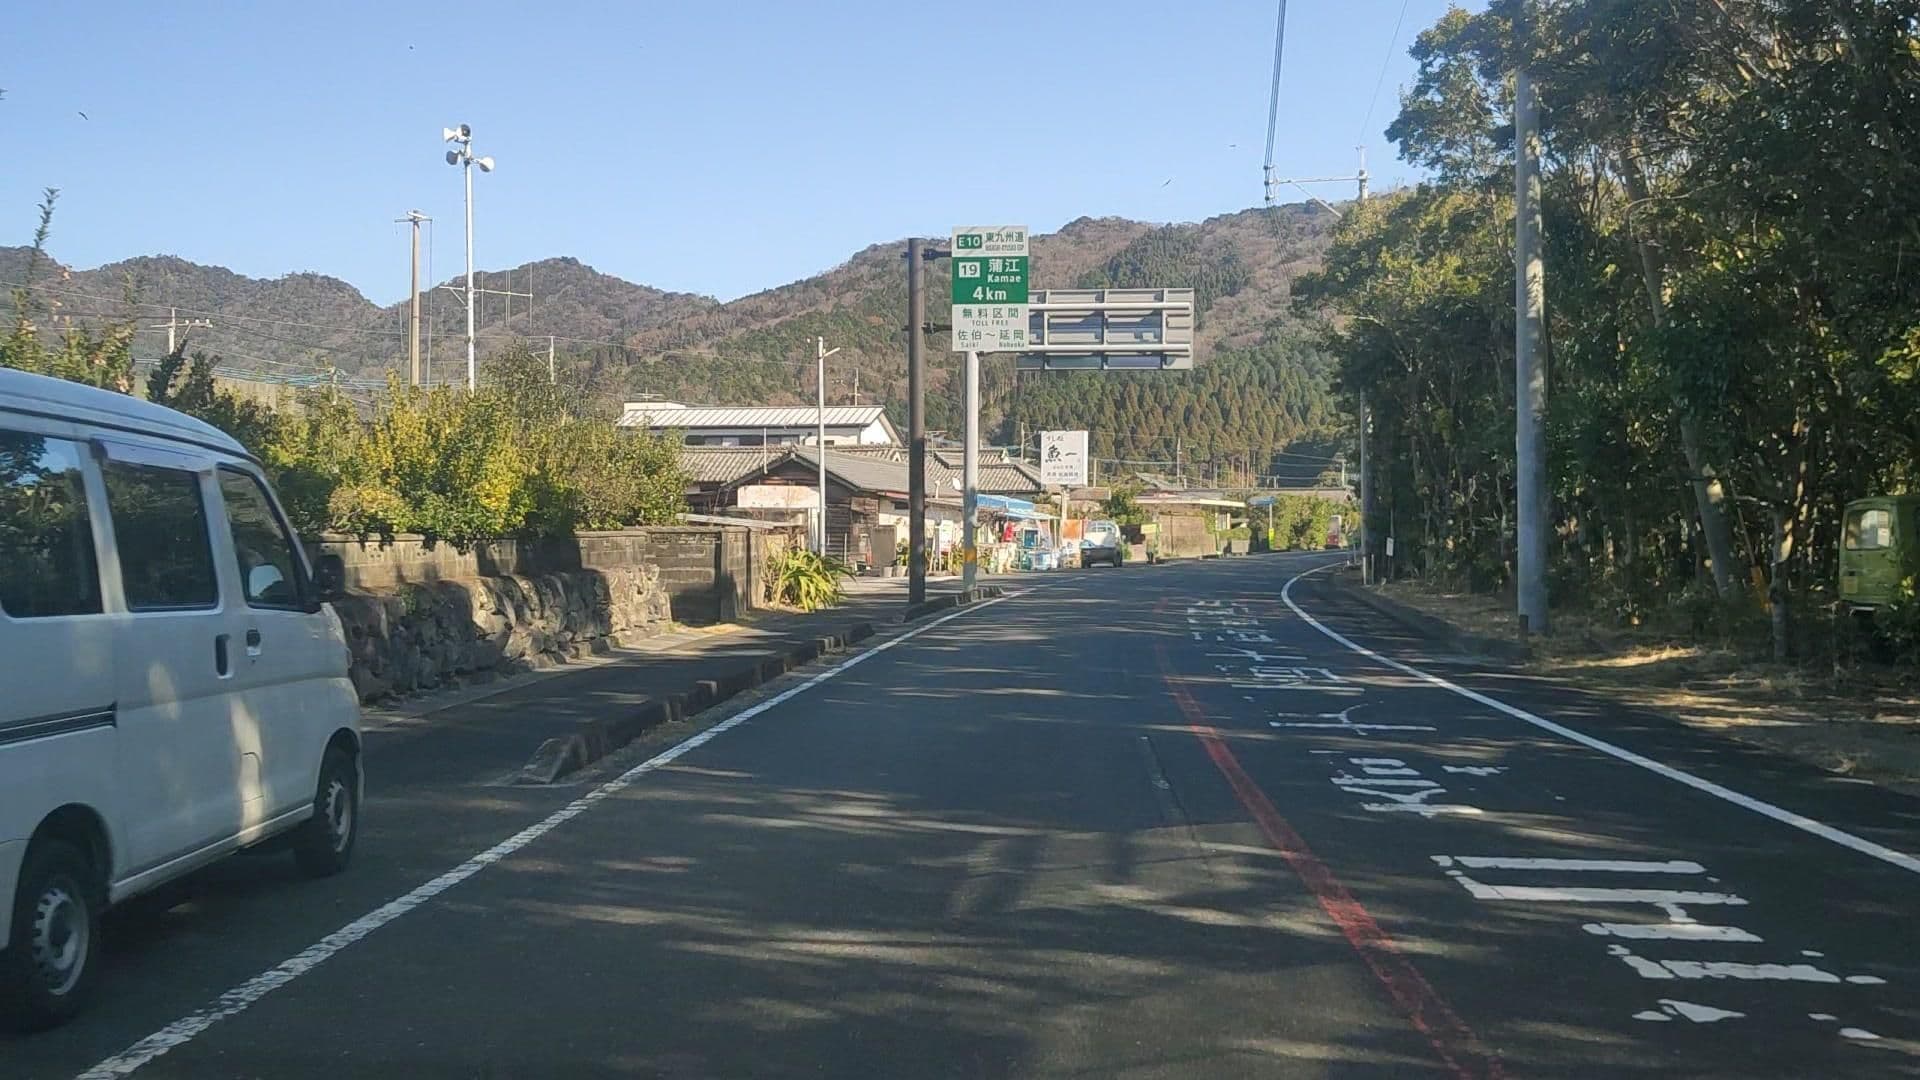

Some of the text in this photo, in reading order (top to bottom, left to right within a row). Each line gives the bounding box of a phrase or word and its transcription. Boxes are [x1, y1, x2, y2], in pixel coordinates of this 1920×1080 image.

[959, 236, 980, 247] E10
[985, 232, 1024, 243] 東九州道
[961, 264, 978, 276] 19
[988, 258, 1020, 273] 蒲江
[987, 274, 1021, 283] Kamae
[962, 307, 1019, 319] 無料区間
